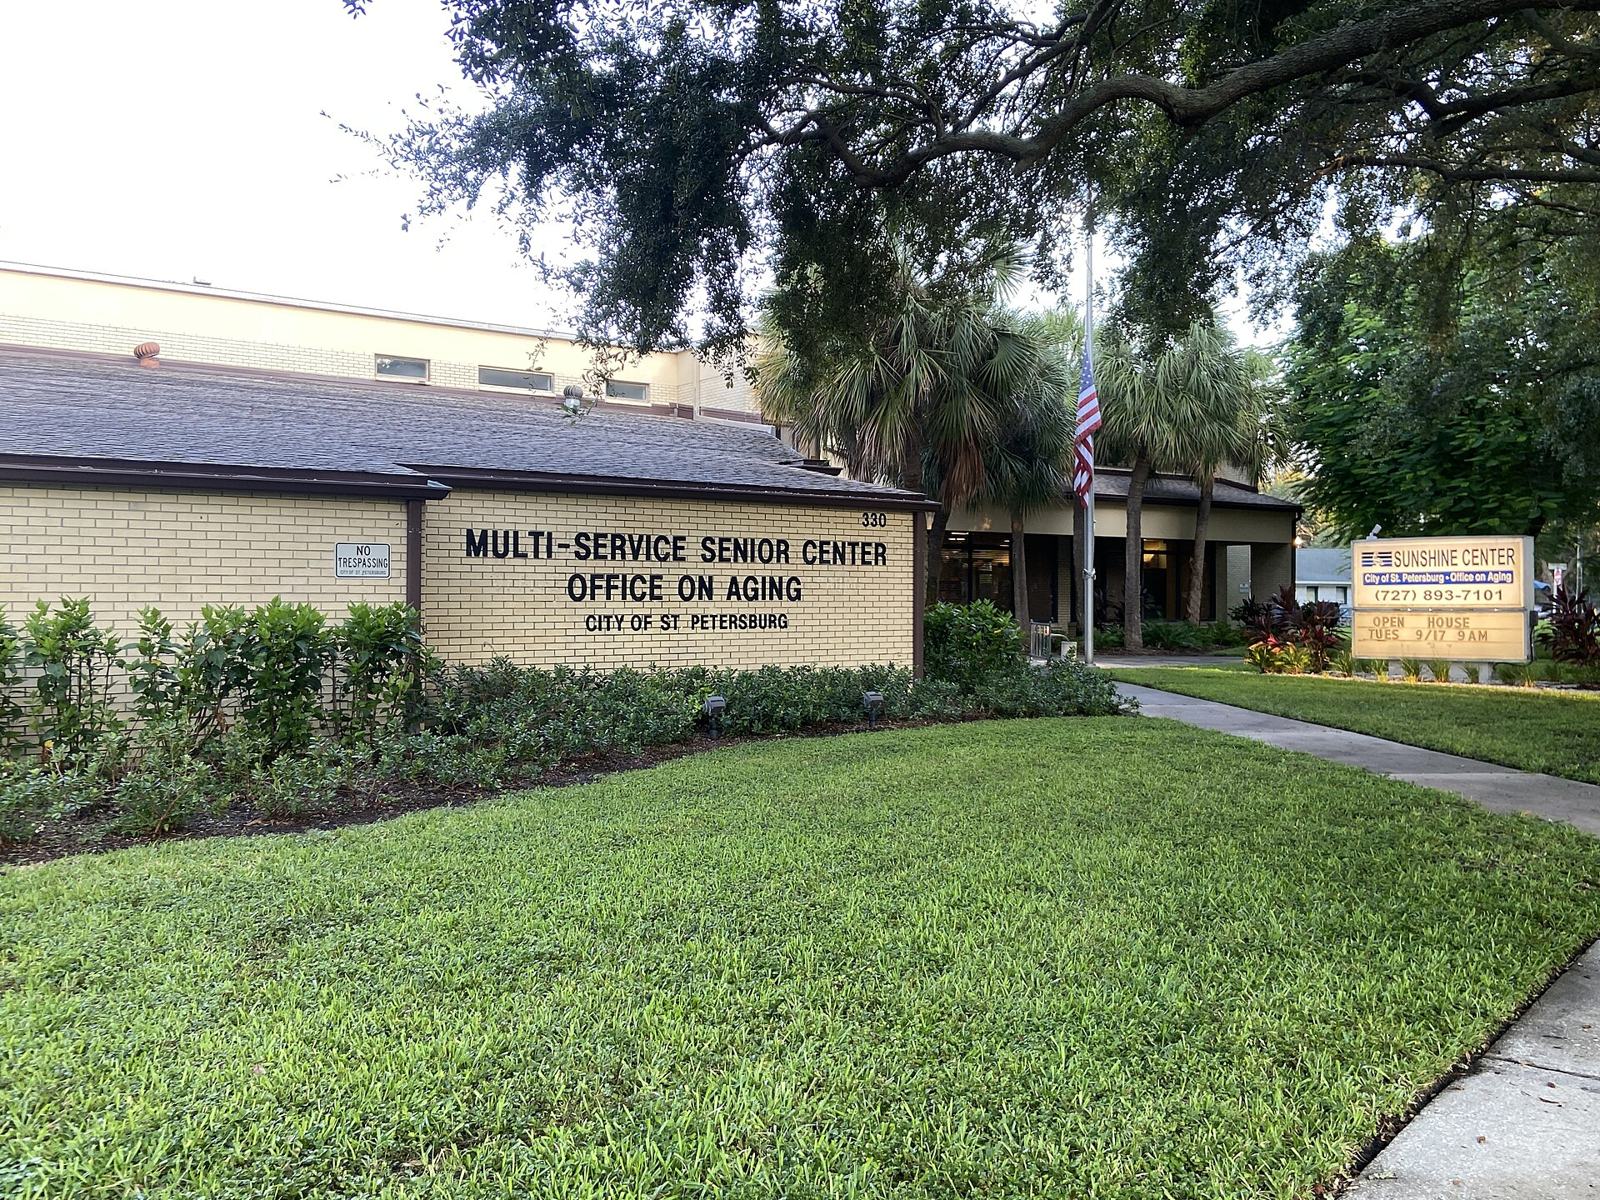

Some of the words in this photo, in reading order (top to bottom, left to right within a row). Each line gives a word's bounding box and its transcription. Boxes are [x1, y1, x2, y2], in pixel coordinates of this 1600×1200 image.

[862, 512, 887, 528] 330
[356, 545, 371, 556] NO
[465, 528, 687, 562] MULTI-SERVICE
[700, 536, 790, 565] SENIOR
[802, 540, 887, 566] CENTER
[338, 557, 388, 569] TRESPASSING
[1394, 549, 1458, 568] SUNSHINE
[1462, 548, 1516, 566] CENTER
[1364, 573, 1380, 585] City
[1380, 573, 1390, 583] of
[1402, 572, 1445, 584] Petersburg
[1475, 574, 1487, 582] on
[1487, 571, 1513, 584] Aging
[567, 573, 664, 602] OFFICE
[677, 574, 714, 602] ON
[726, 575, 802, 602] AGING
[1375, 589, 1417, 602] (727)
[1423, 589, 1503, 601] 893-7101
[585, 614, 624, 632] CITY
[630, 614, 653, 632] OF
[660, 614, 680, 631] ST
[691, 613, 789, 630] PETERSBURG
[1372, 616, 1405, 628] OPEN
[1427, 616, 1470, 629] HOUSE
[1368, 628, 1400, 641] TUES
[1415, 629, 1446, 641] 9/17
